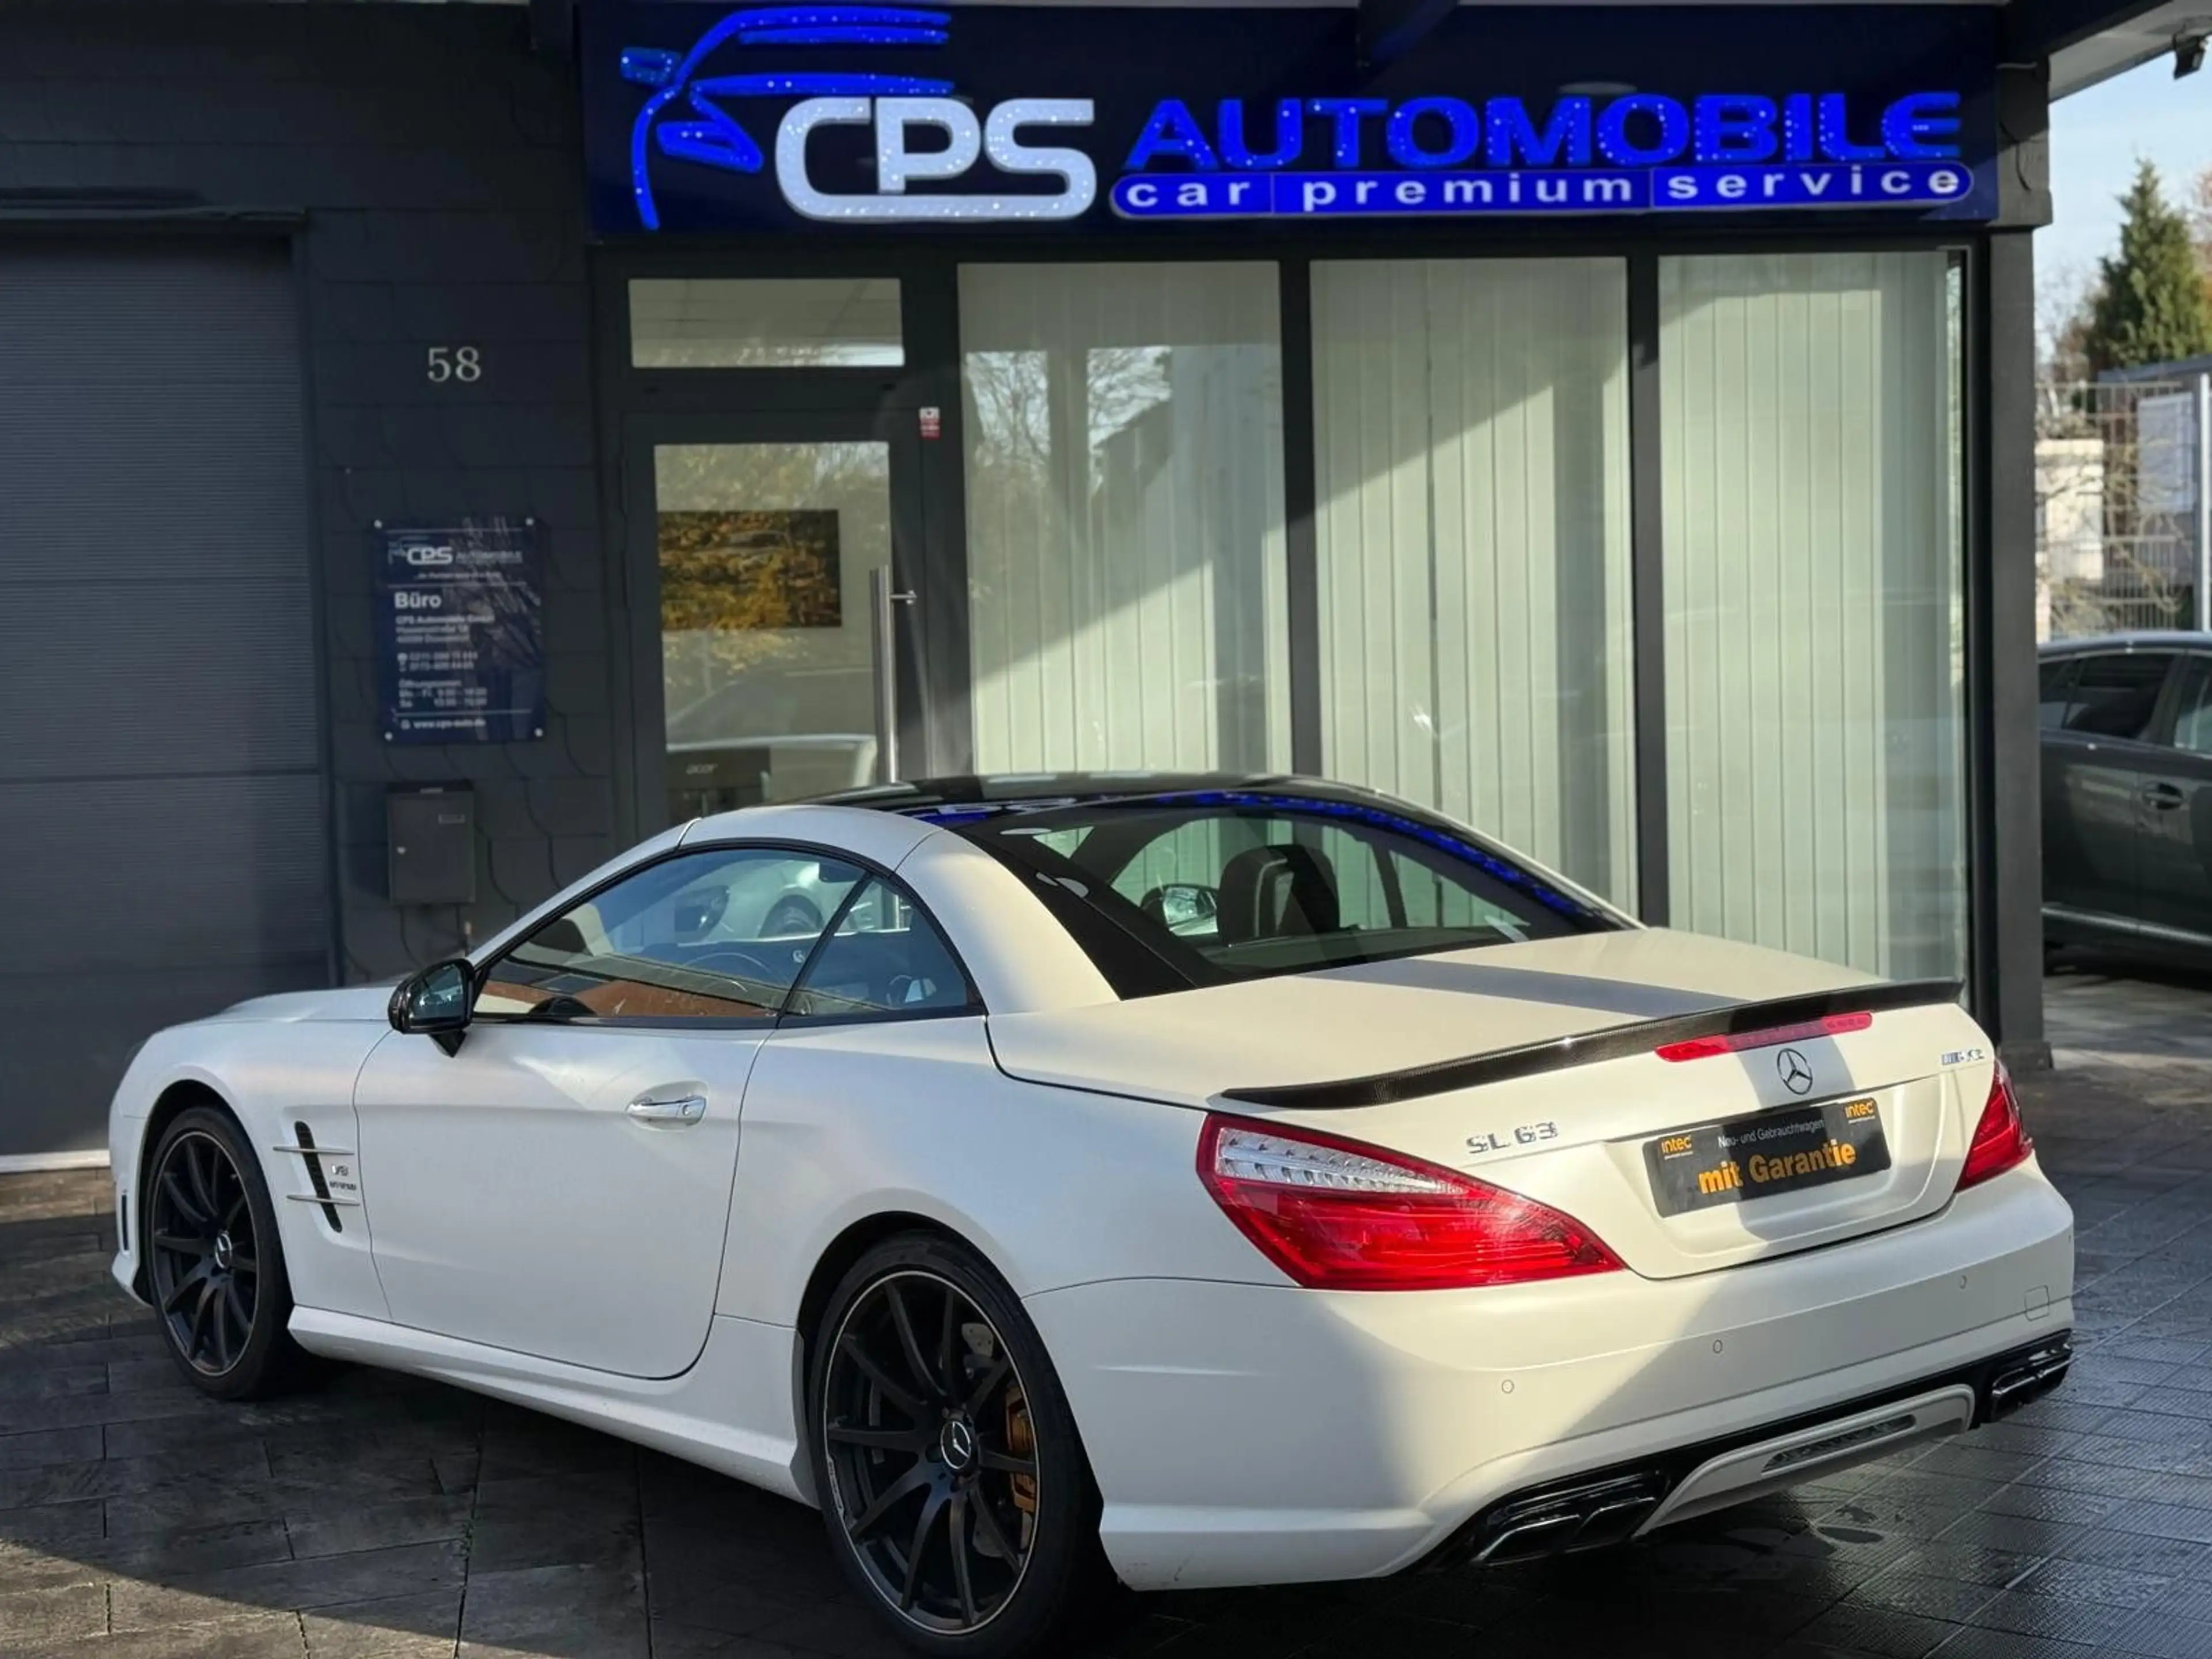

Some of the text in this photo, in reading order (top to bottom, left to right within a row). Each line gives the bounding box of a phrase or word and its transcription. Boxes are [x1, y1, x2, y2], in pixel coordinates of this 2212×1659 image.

[1122, 91, 1962, 171] AUTOMOBILE
[774, 96, 1097, 221] CPS
[1126, 165, 1959, 213] car premium service
[427, 346, 482, 382] 58
[406, 546, 453, 565] CPS
[394, 591, 442, 609] Büro
[1466, 1121, 1558, 1154] SL 63
[1697, 1138, 1857, 1195] mit Garantie
